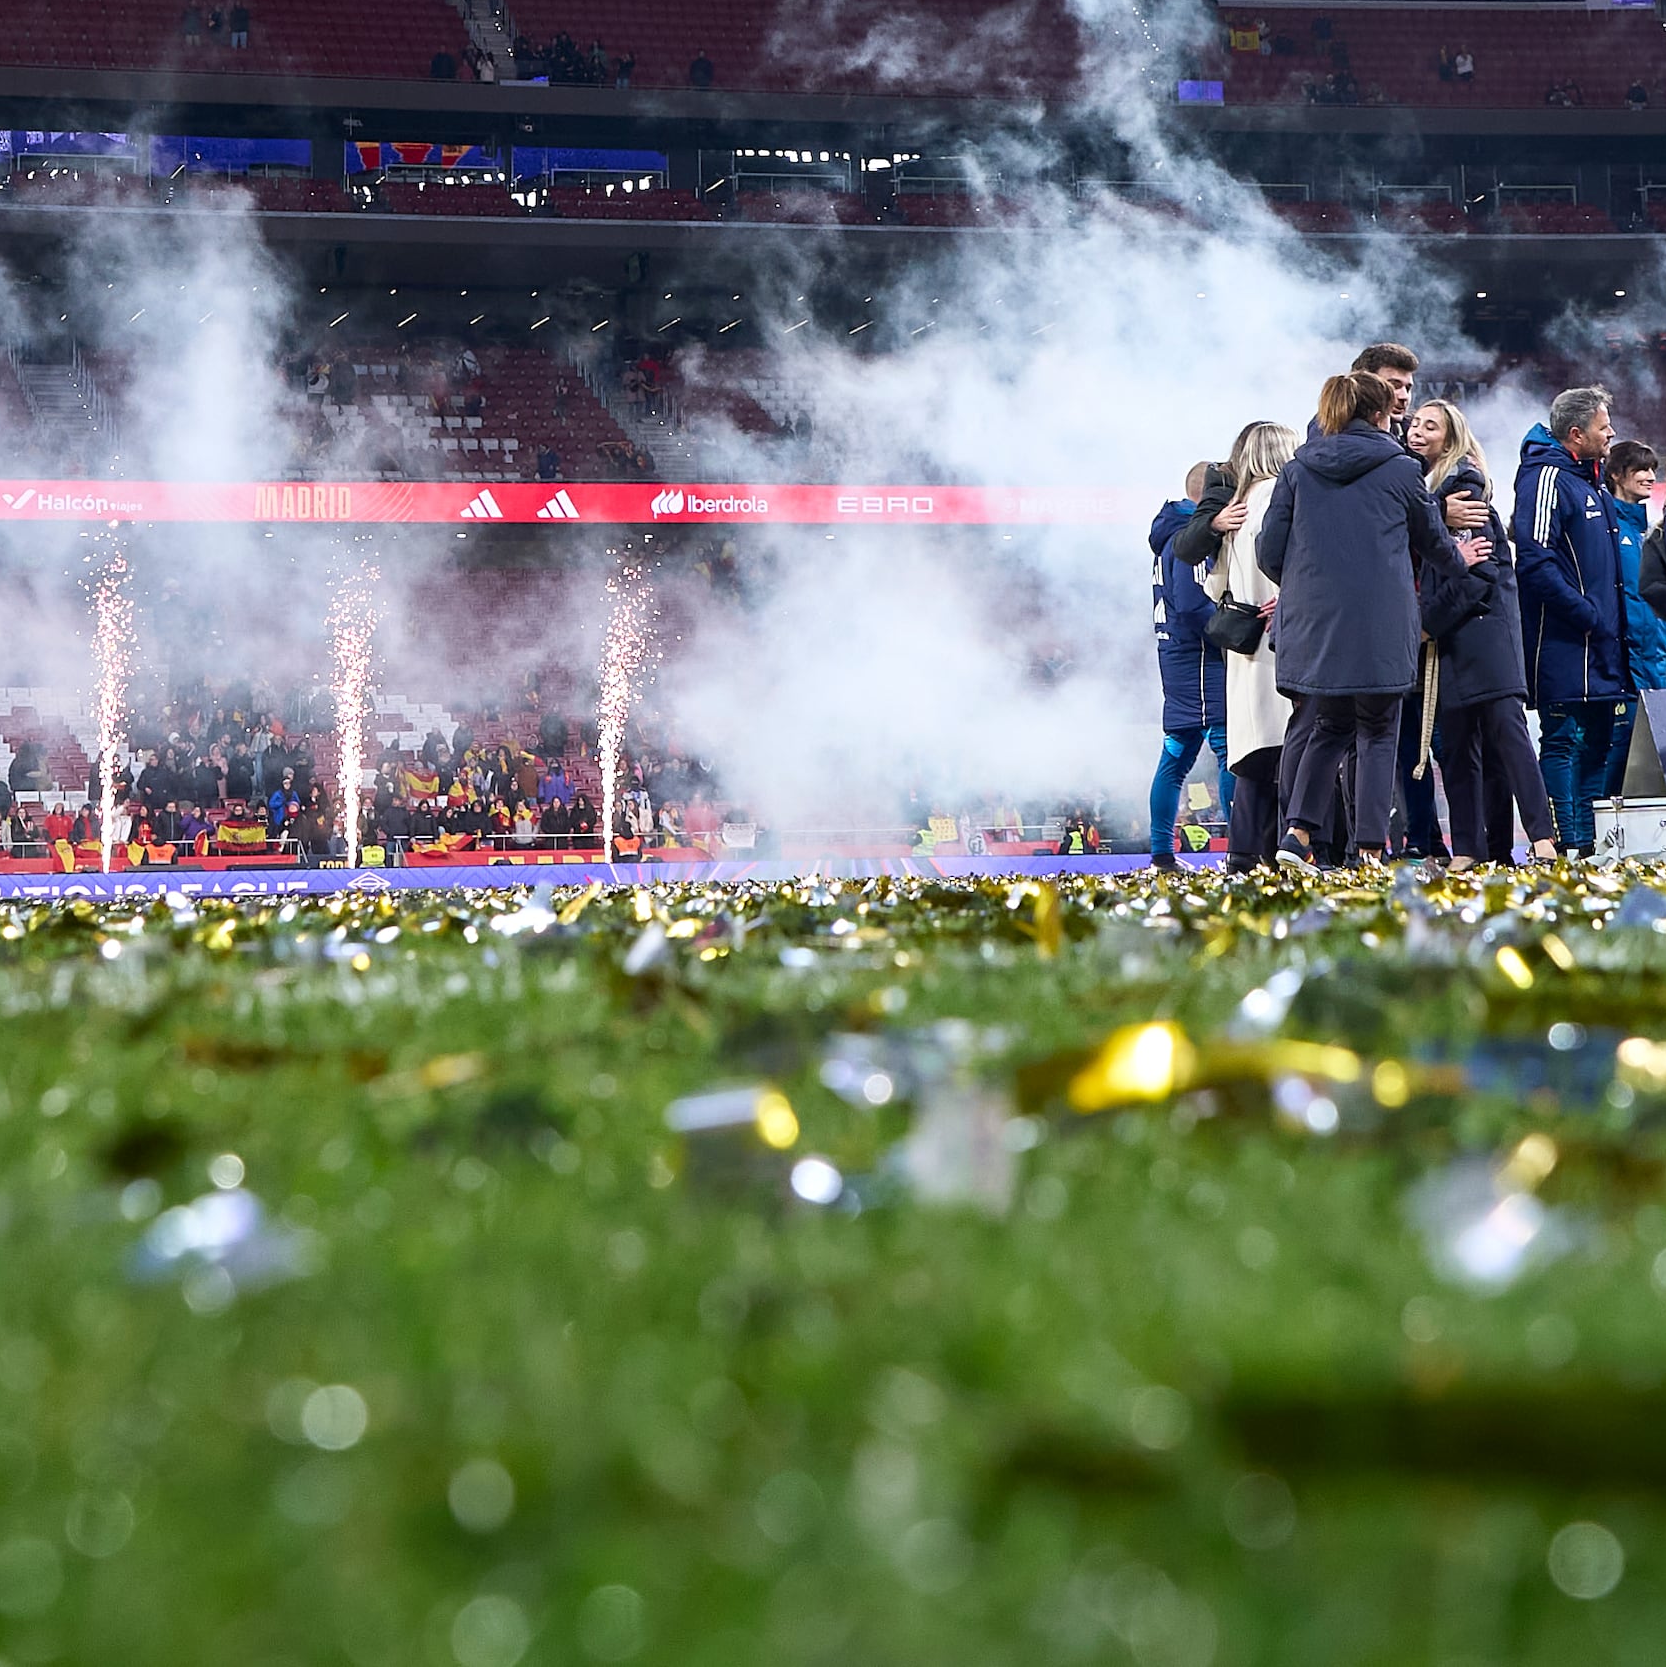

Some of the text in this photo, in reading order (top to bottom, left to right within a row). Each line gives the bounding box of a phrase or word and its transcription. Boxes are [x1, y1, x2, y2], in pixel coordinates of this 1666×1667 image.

[38, 492, 107, 511] Halcón
[254, 486, 351, 520] MADRID
[687, 494, 768, 514] Iberdrola
[837, 497, 933, 514] EBRO
